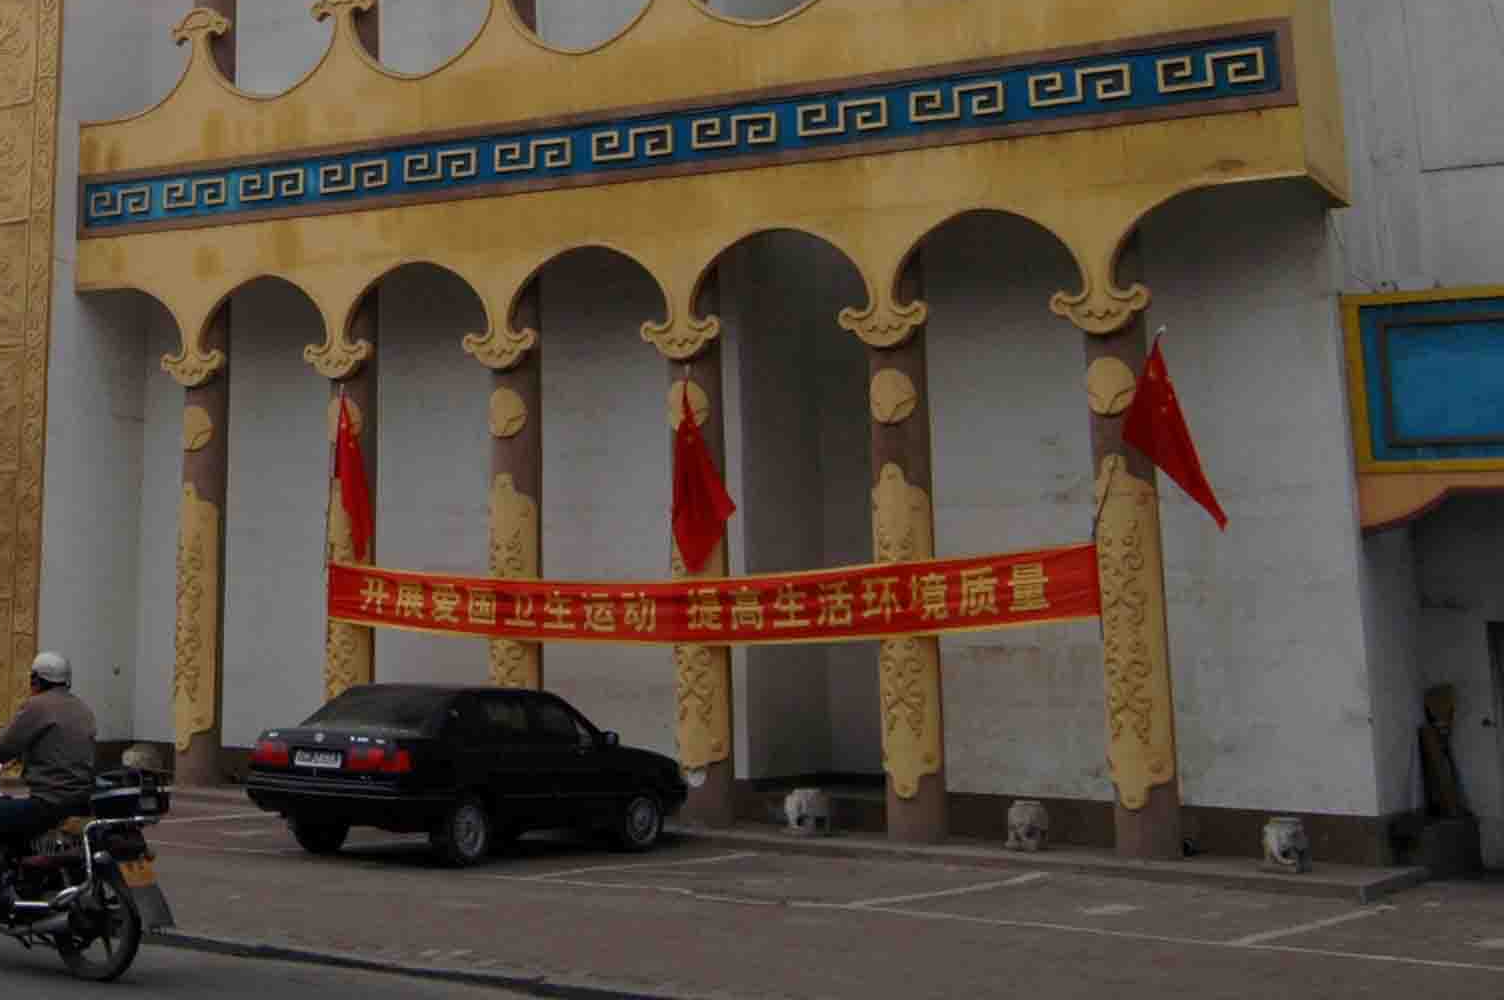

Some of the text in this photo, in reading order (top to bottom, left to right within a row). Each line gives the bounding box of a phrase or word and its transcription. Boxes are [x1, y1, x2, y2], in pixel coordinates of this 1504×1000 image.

[358, 562, 1052, 634] 开展爱国卫生运动 提高生活环境质量
